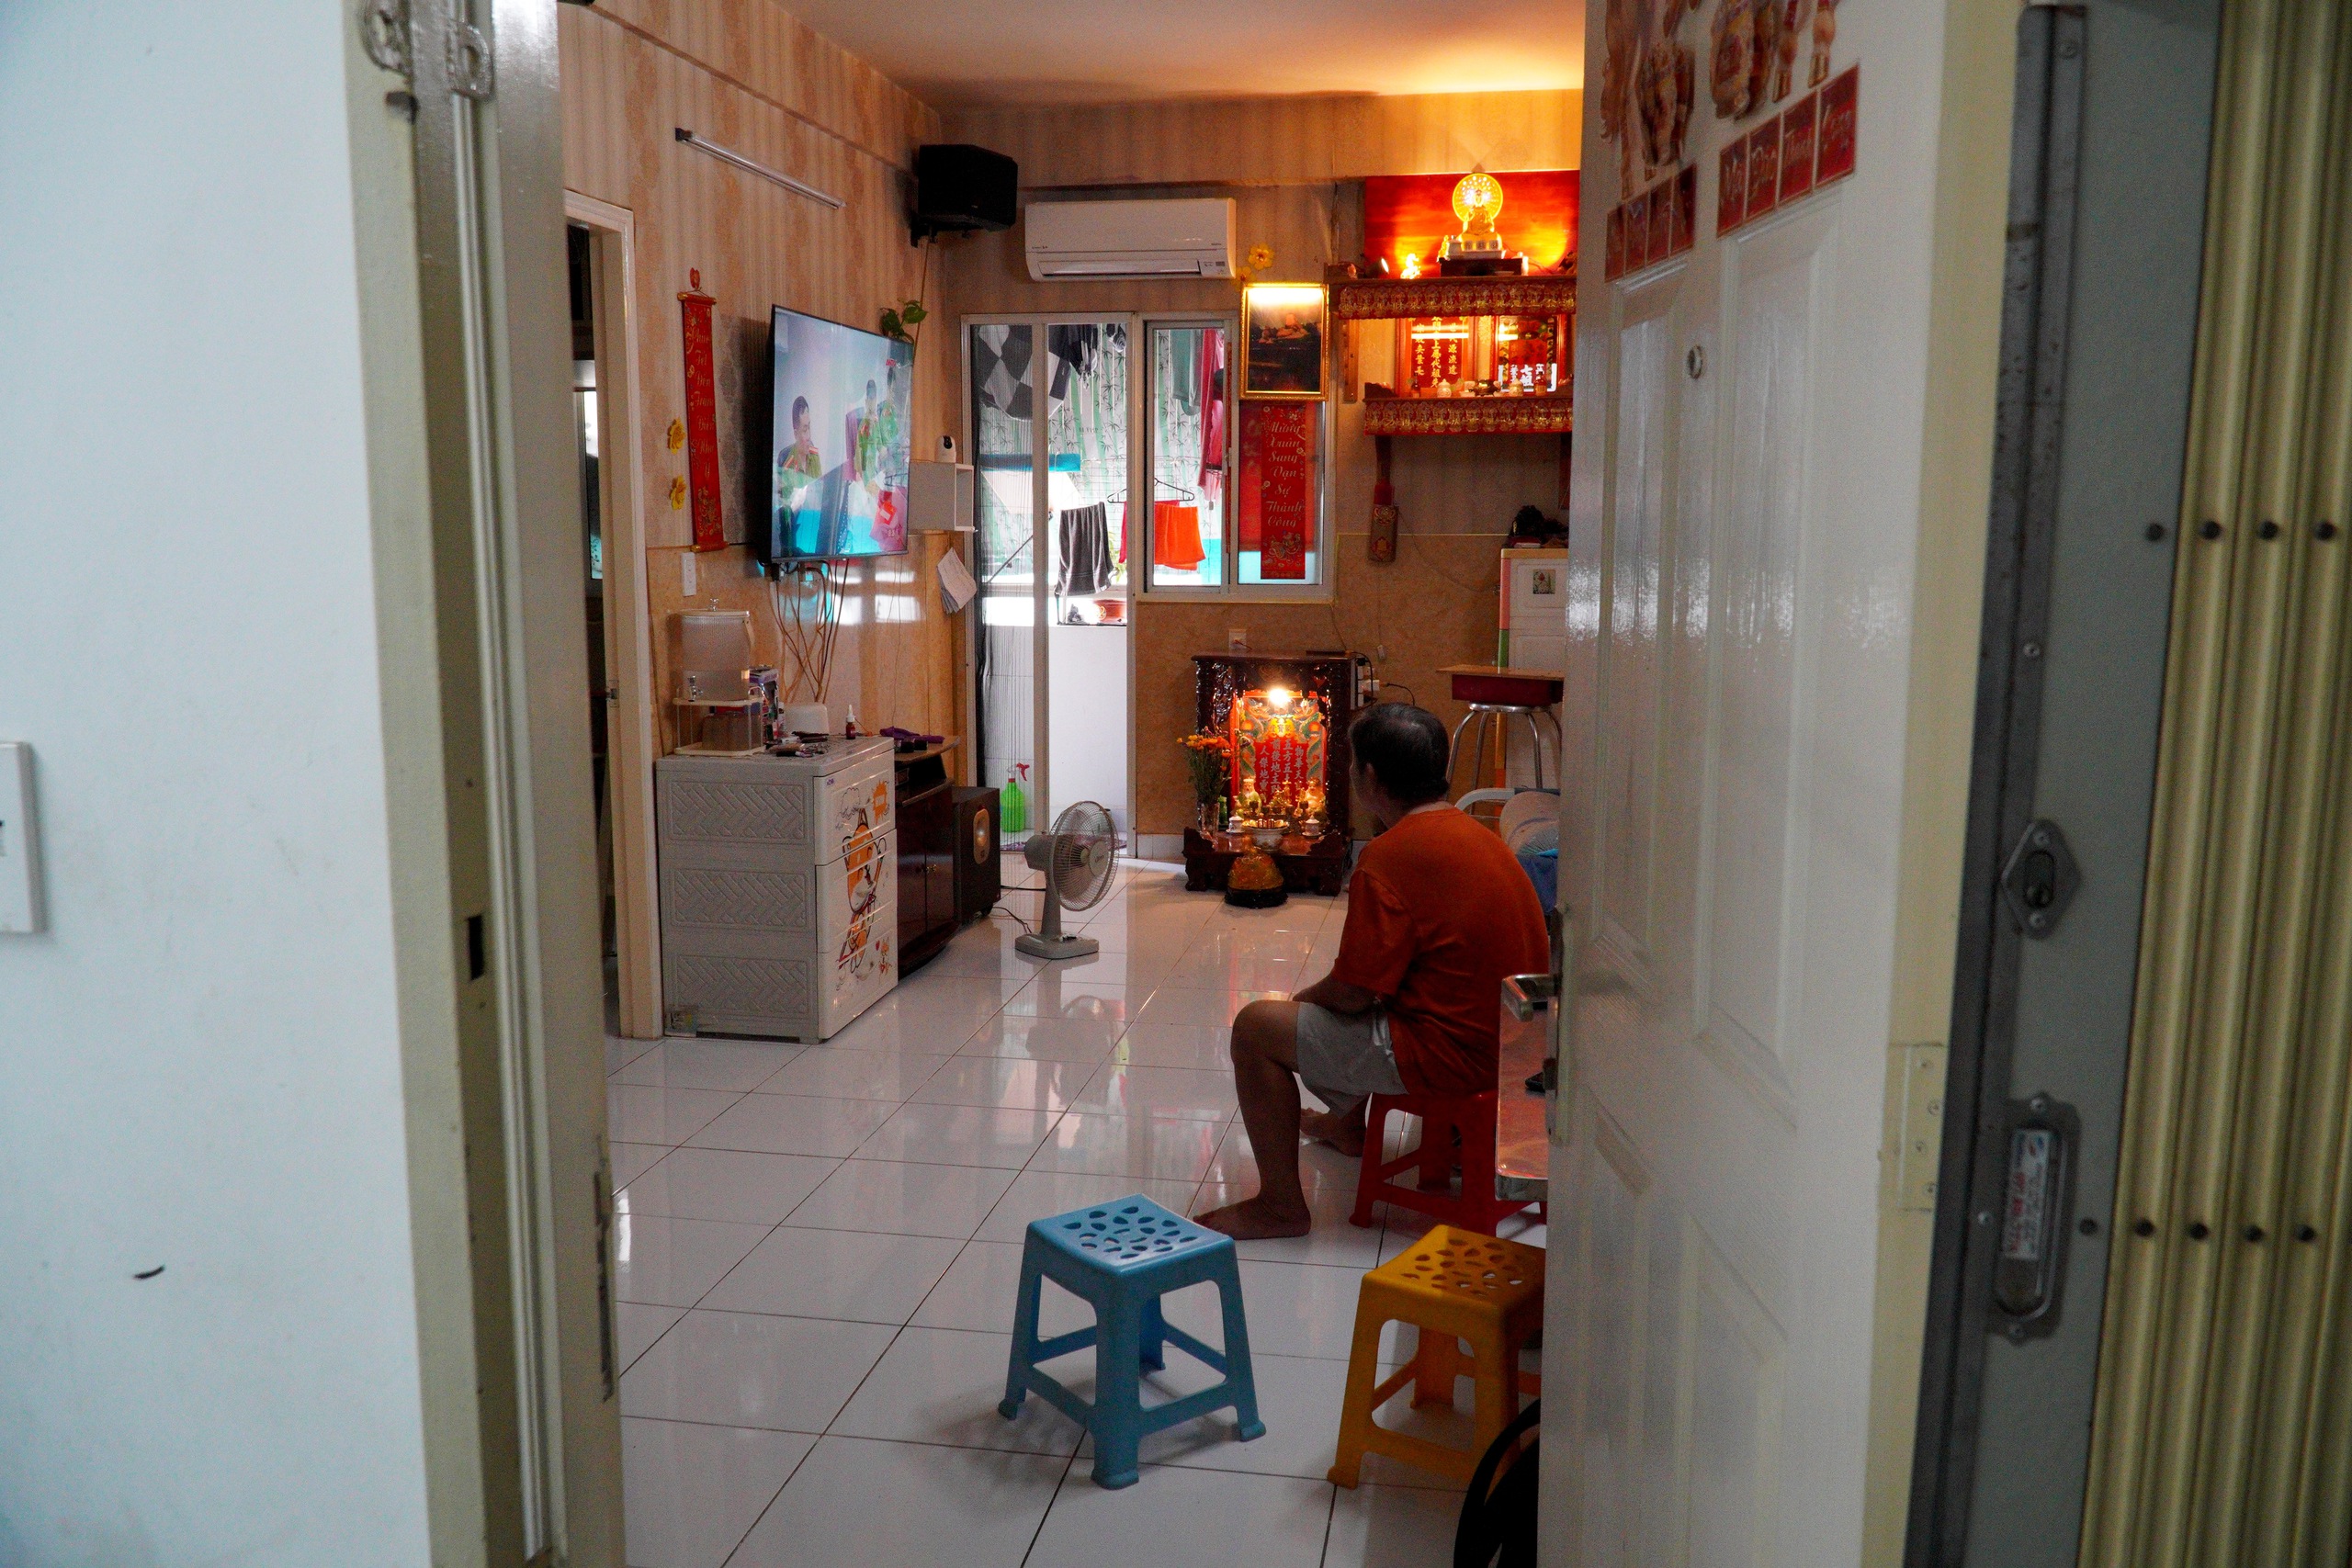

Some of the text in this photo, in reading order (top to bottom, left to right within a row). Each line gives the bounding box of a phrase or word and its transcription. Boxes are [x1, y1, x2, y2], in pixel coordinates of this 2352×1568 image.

[1271, 421, 1300, 436] Mừng
[1268, 436, 1299, 448] Xuân
[1269, 451, 1297, 463] Sang
[1271, 466, 1296, 480] Vạn
[1274, 484, 1291, 498] Sự
[1265, 501, 1302, 513] Thành
[1268, 515, 1296, 528] Công
